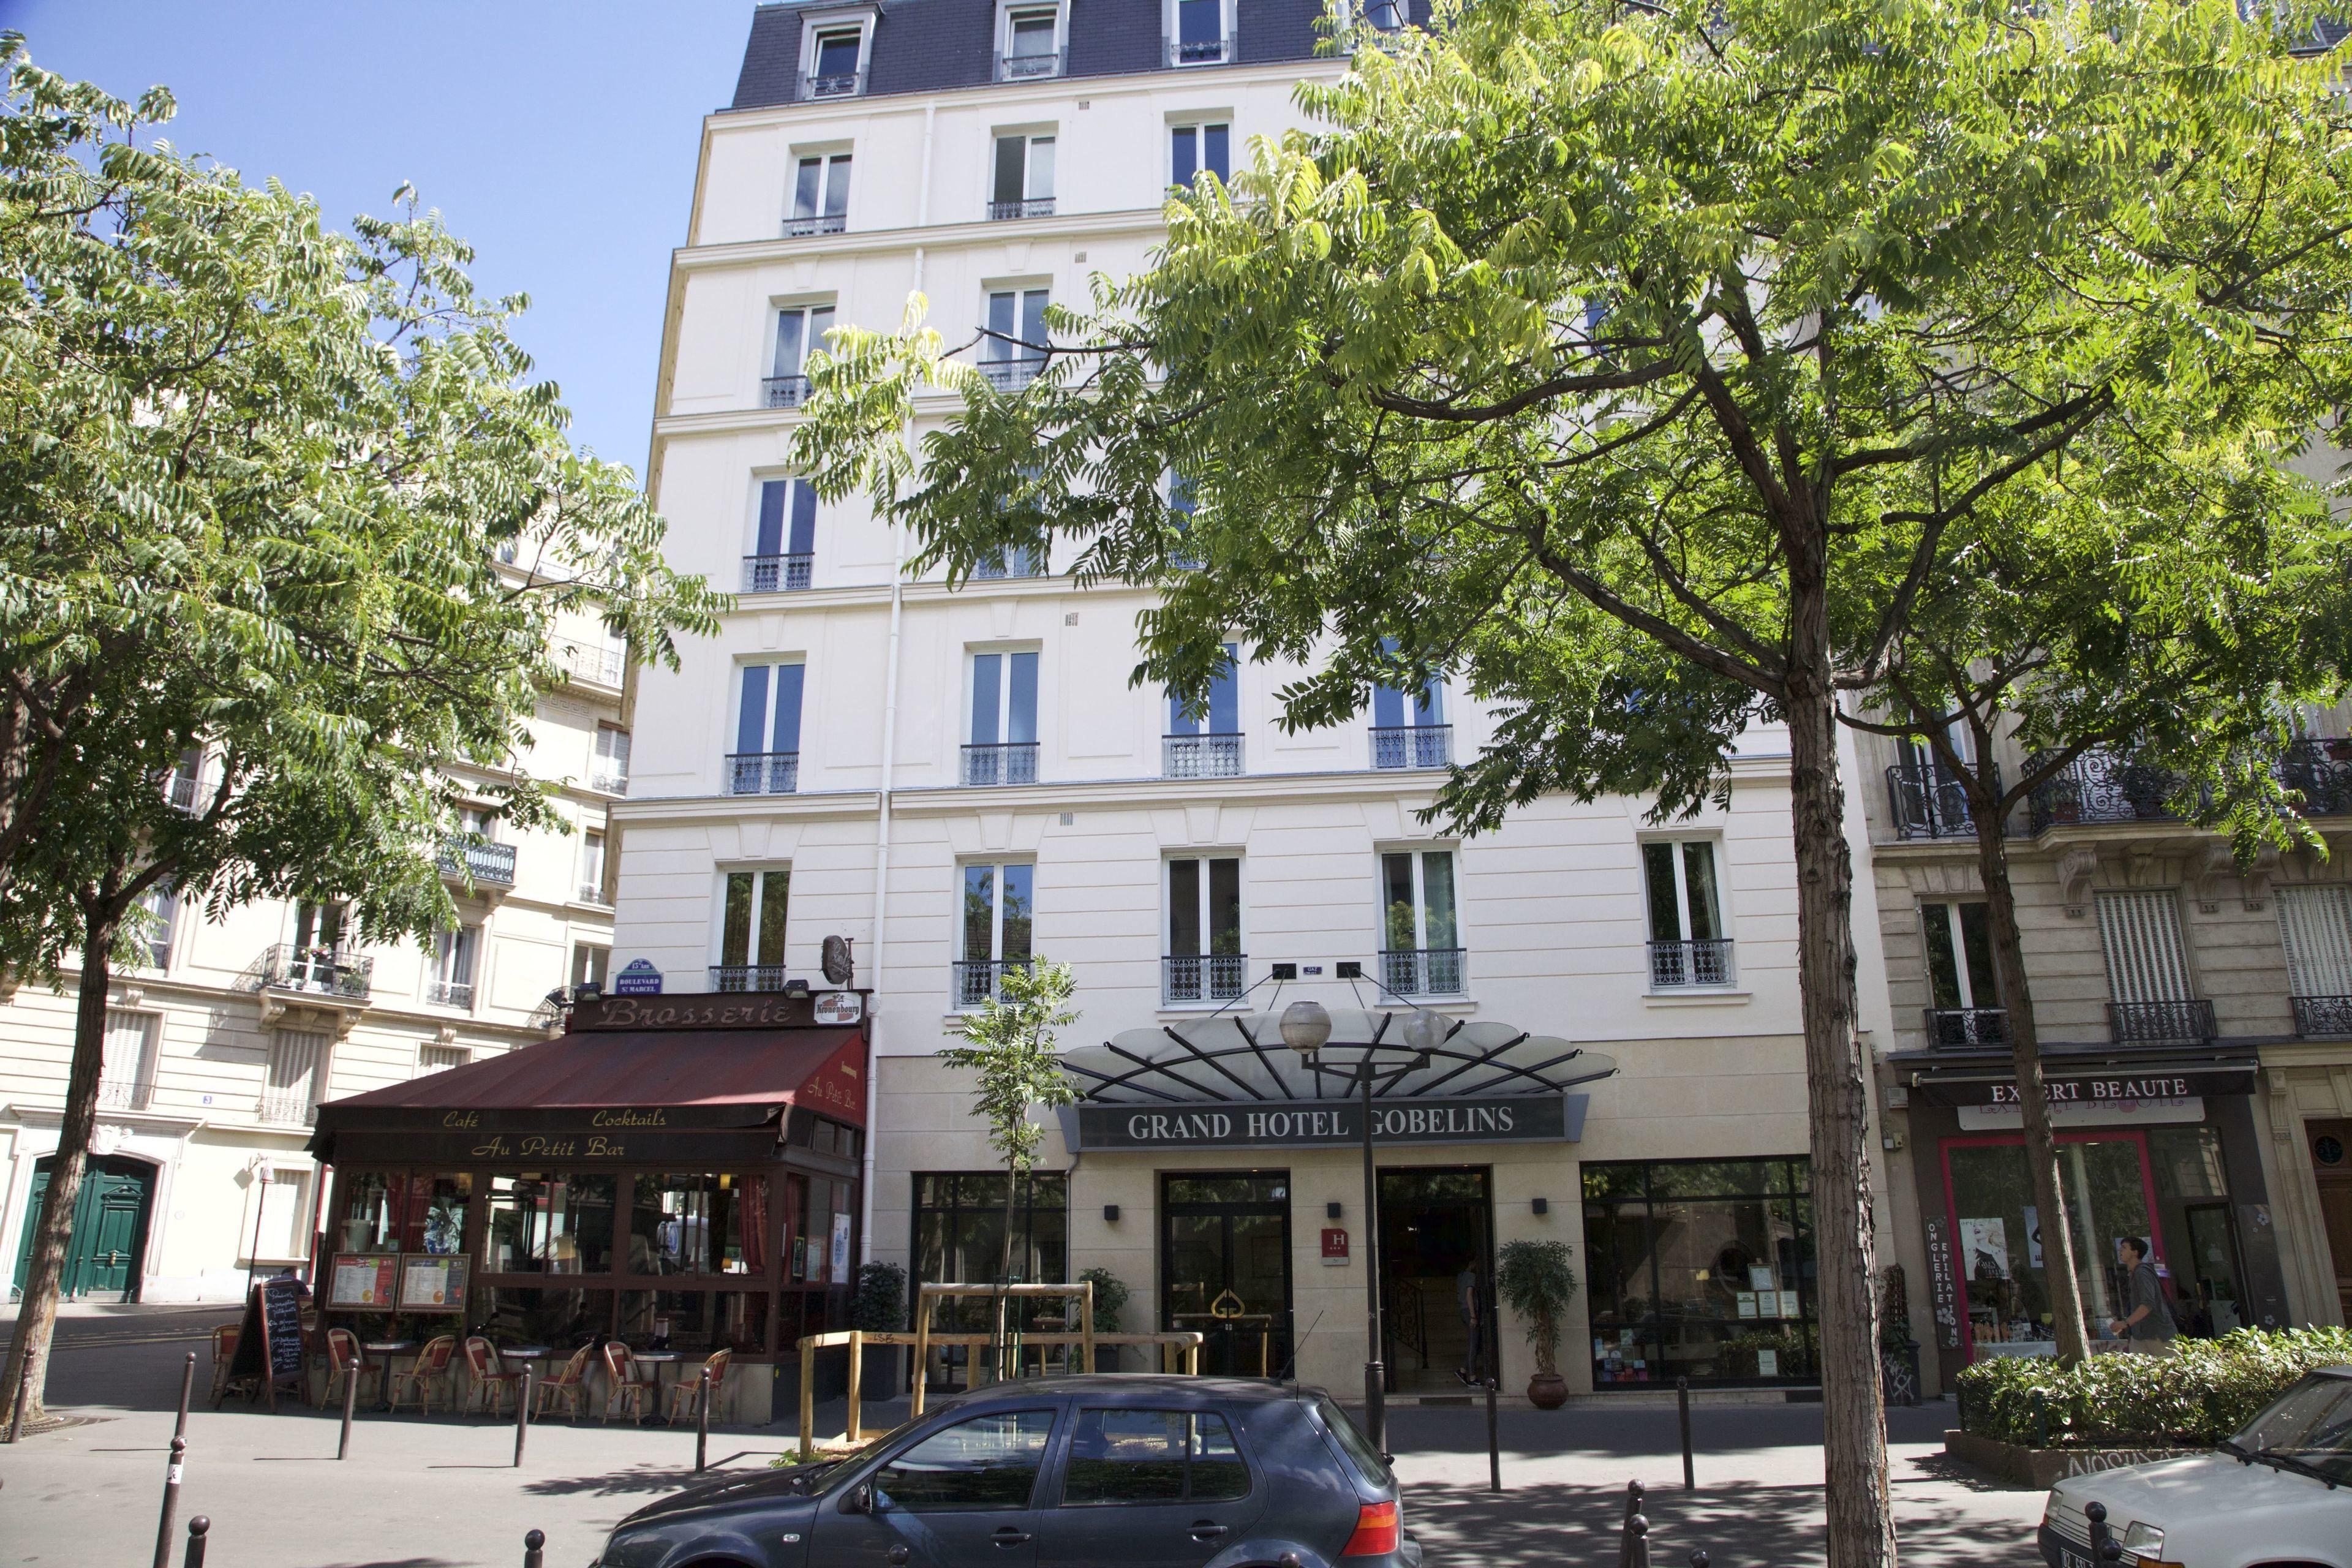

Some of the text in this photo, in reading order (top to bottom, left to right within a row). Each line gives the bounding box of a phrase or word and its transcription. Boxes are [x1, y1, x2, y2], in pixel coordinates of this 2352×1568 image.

[595, 998, 791, 1026] Brasserie
[816, 1004, 859, 1015] Kronenbourg
[807, 1077, 823, 1097] Au
[826, 1082, 842, 1105] Petit
[2092, 1079, 2187, 1098] BEAUTE
[443, 1111, 478, 1129] Café
[592, 1109, 666, 1126] Cocktails
[1128, 1114, 1231, 1140] GRAND
[1246, 1112, 1349, 1137] HOTEL
[472, 1137, 625, 1158] Au Petit Bar
[1333, 1234, 1344, 1245] H
[1929, 1224, 1944, 1303] ONGLERIE
[1942, 1243, 1958, 1336] EPILATION
